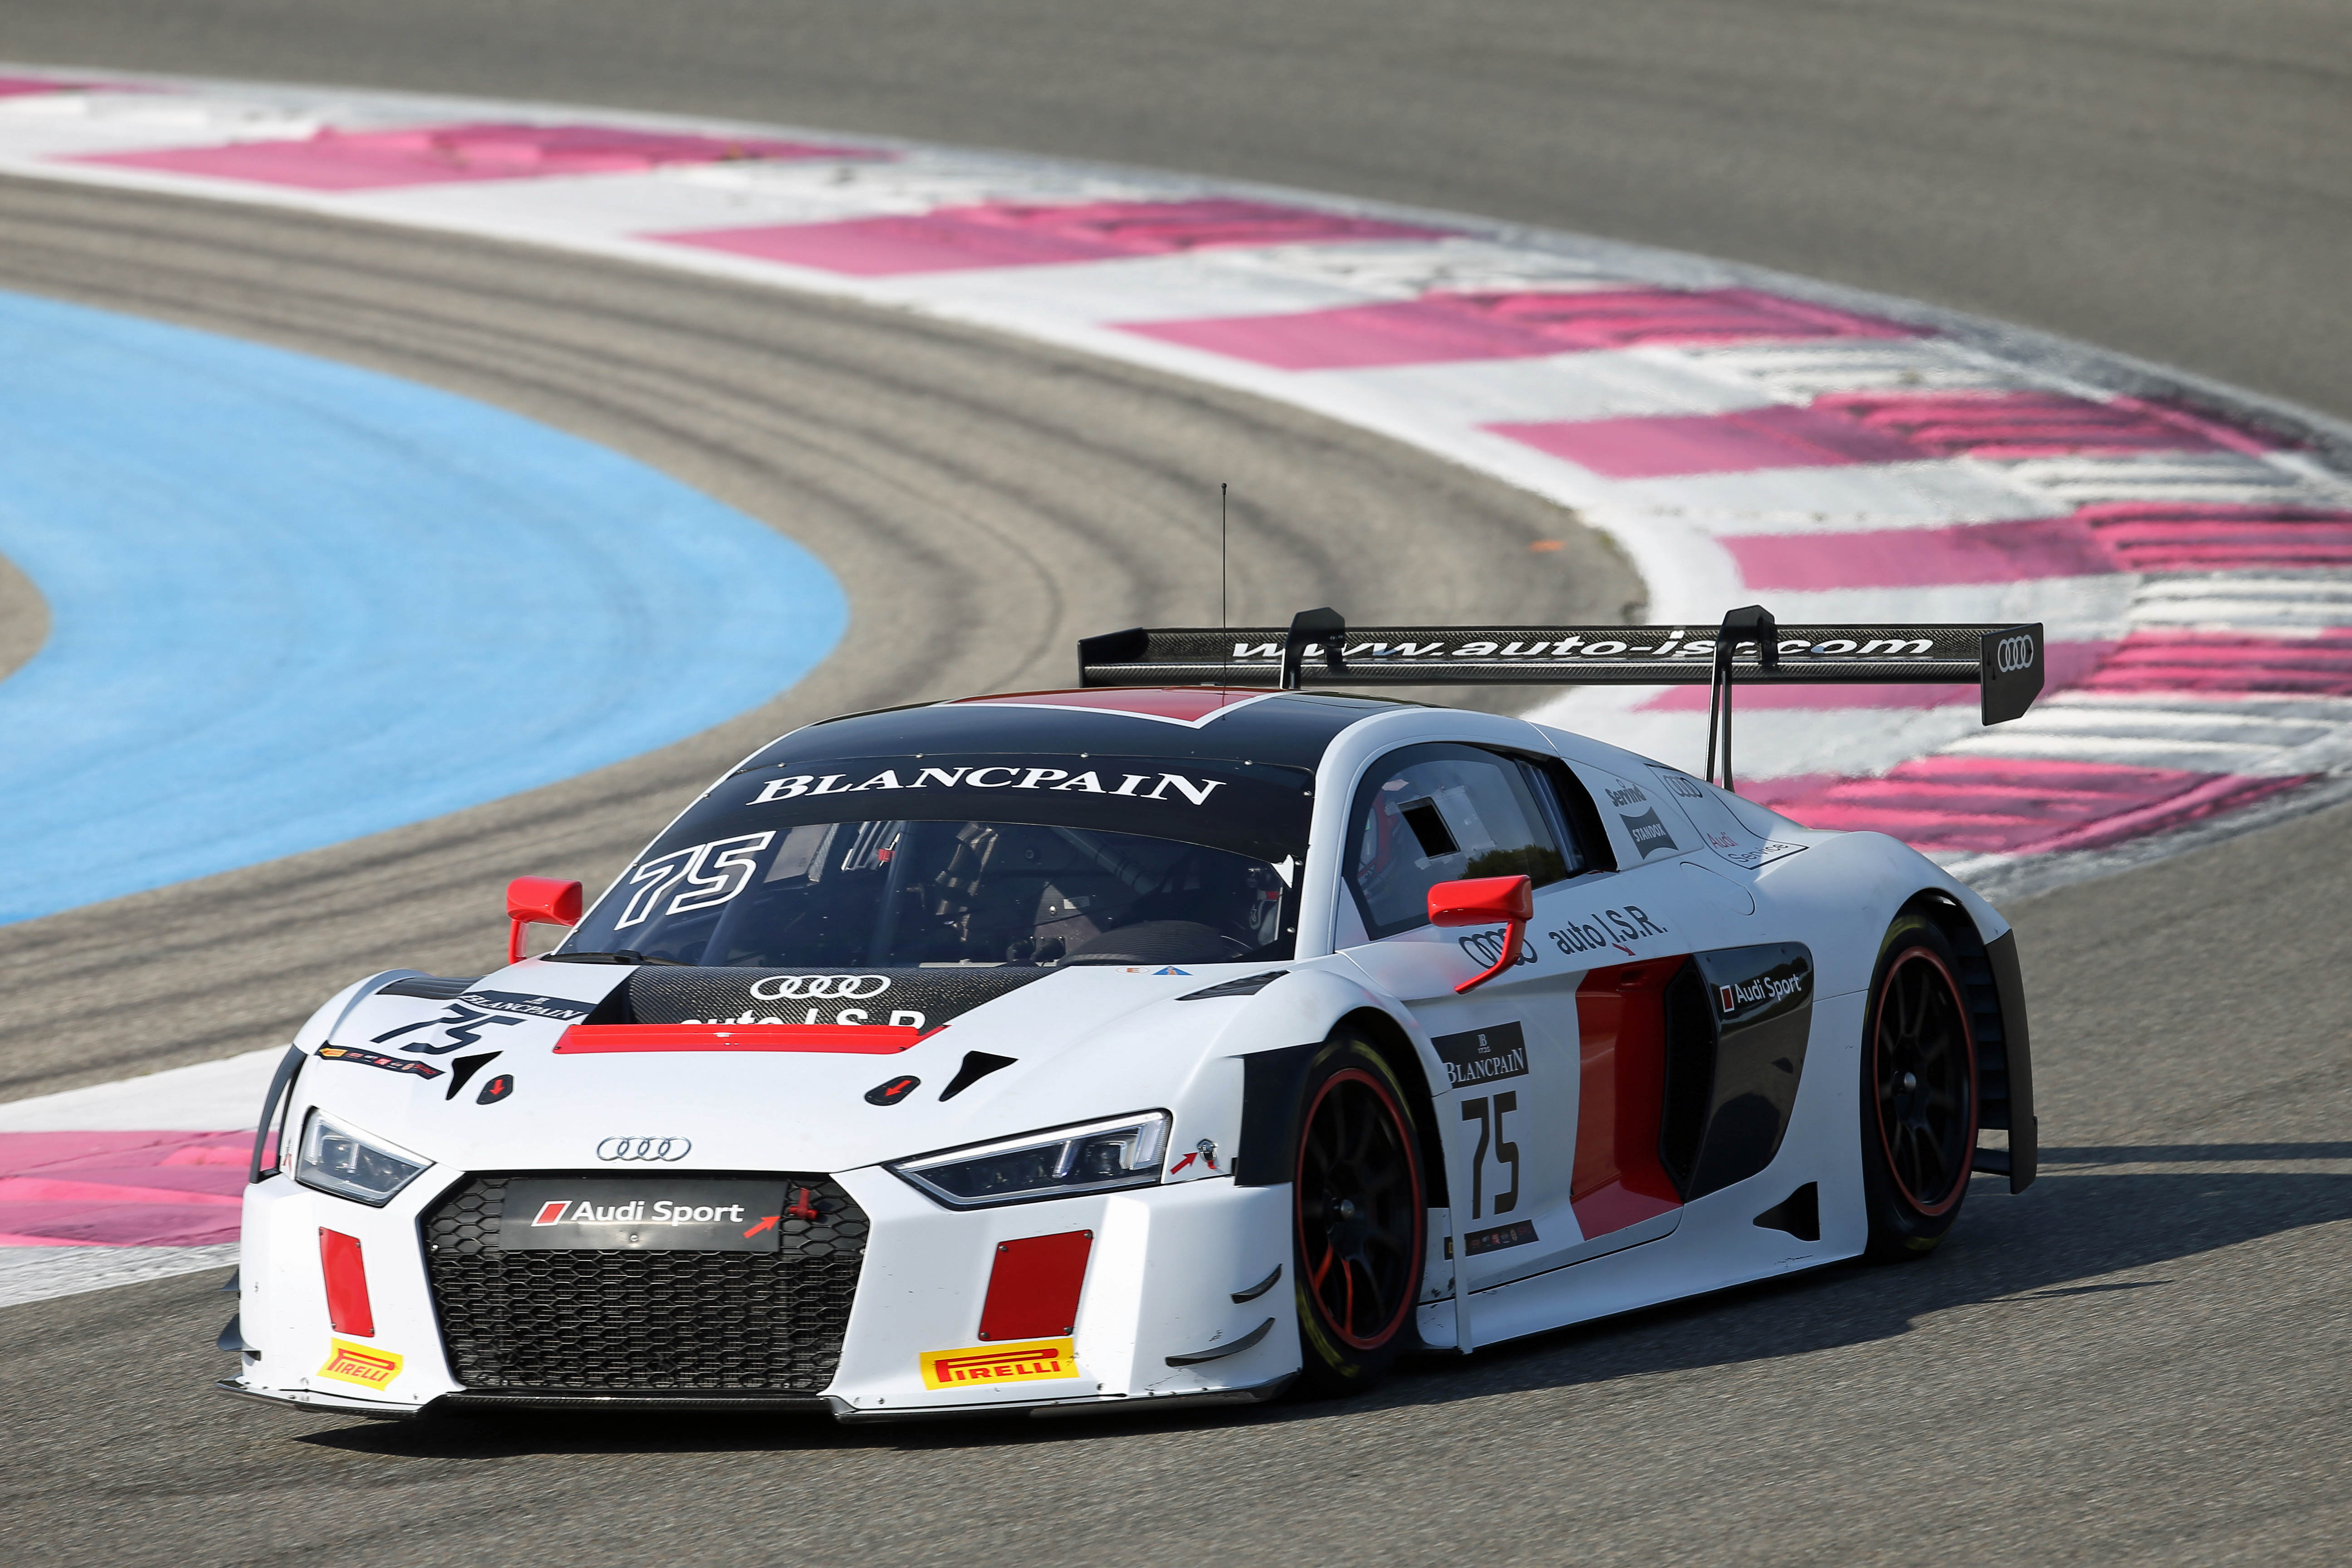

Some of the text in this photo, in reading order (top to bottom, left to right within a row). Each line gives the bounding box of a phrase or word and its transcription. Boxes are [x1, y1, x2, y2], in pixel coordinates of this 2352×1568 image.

[746, 766, 1226, 806] BLANCPAIN
[1632, 823, 1666, 842] STANDOX
[1707, 832, 1739, 849] Audi
[1728, 844, 1788, 862] Service
[613, 830, 777, 931] 75
[1548, 905, 1668, 955] auto I.S.R.
[1735, 974, 1802, 1003] Audi Sport
[456, 995, 584, 1019] BLANCPAIN
[370, 1003, 527, 1054] 75
[1443, 1048, 1524, 1083] BLANCPAIN
[1461, 1090, 1519, 1220] 75
[570, 1200, 745, 1226] Audi Sport
[327, 1348, 395, 1382] PIRELLI
[936, 1348, 1060, 1383] PIRELLI
